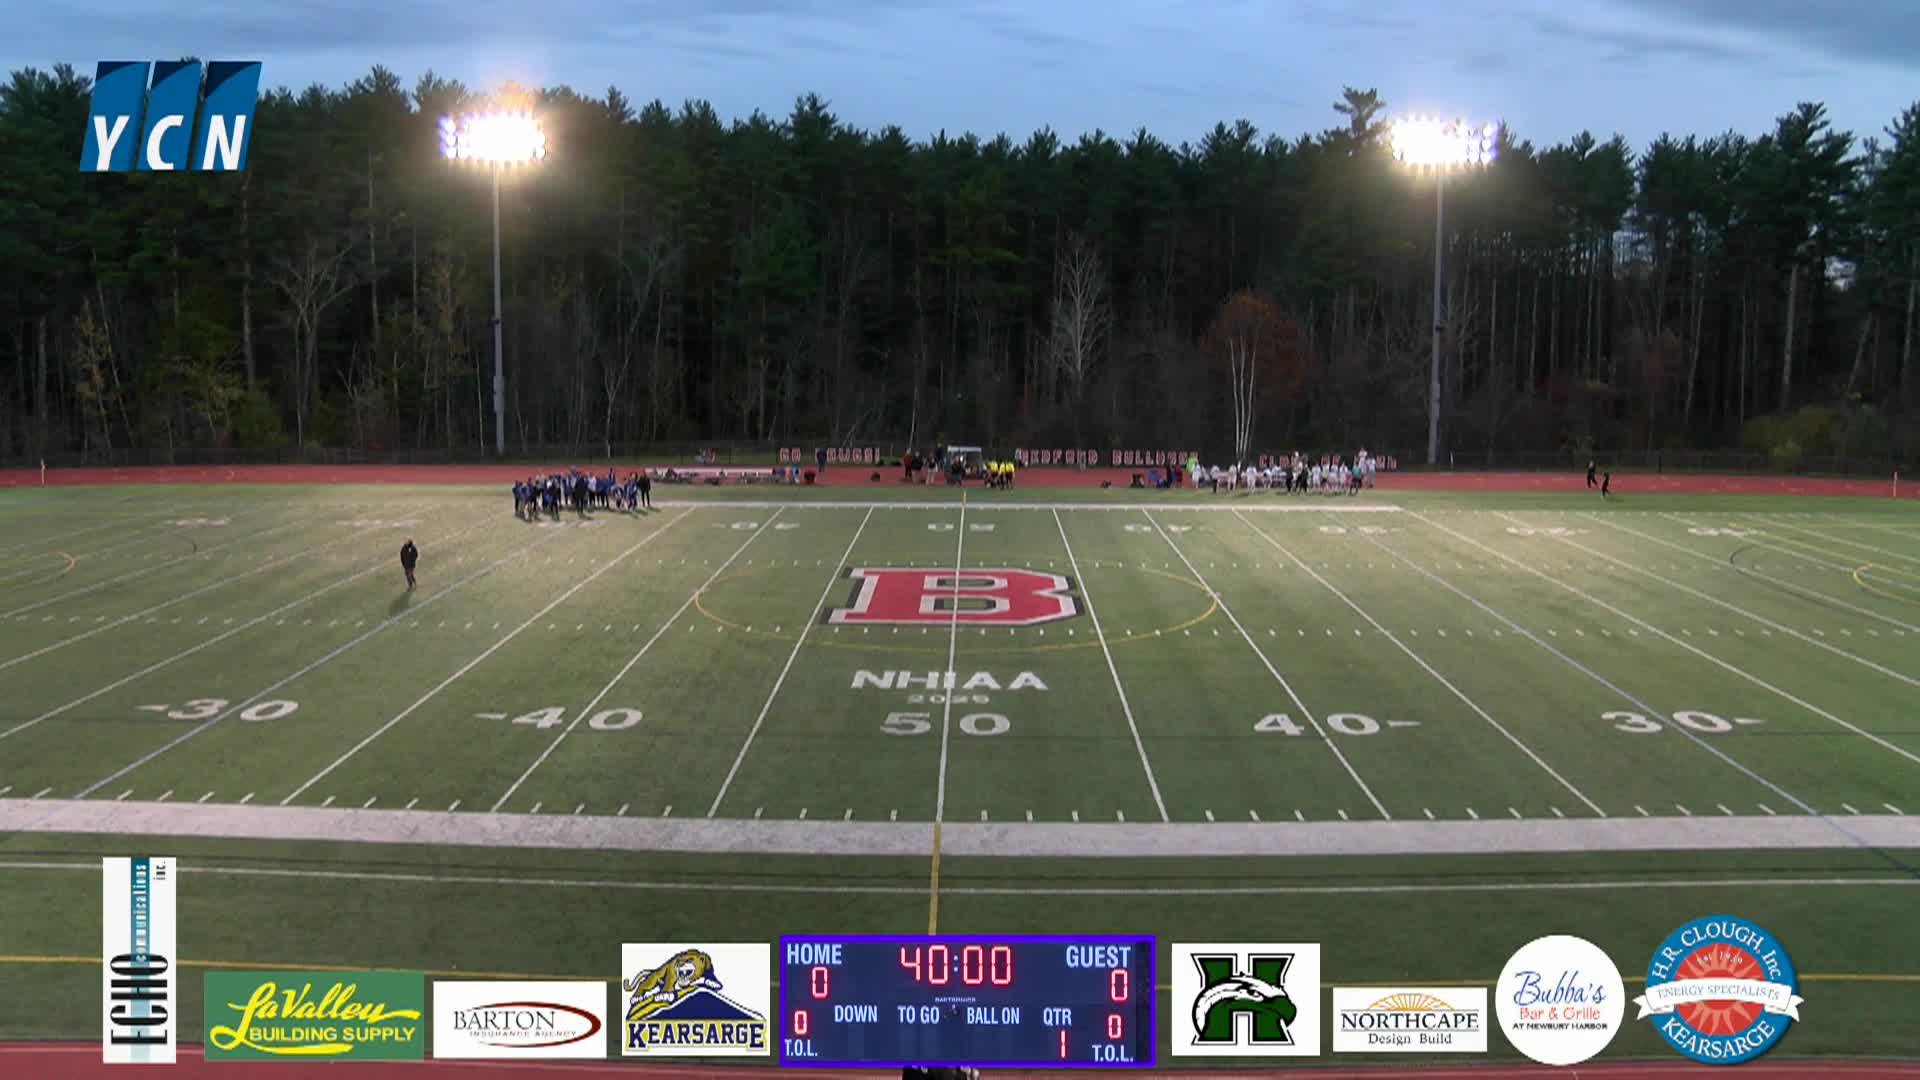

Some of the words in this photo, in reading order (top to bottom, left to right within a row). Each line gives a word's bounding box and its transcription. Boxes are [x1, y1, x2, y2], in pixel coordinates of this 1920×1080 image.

[850, 669, 1049, 690] NHIAA
[166, 699, 299, 721] 30
[511, 706, 643, 730] 40
[880, 712, 1011, 735] 50
[1253, 712, 1380, 736] 40
[1601, 711, 1733, 733] 30
